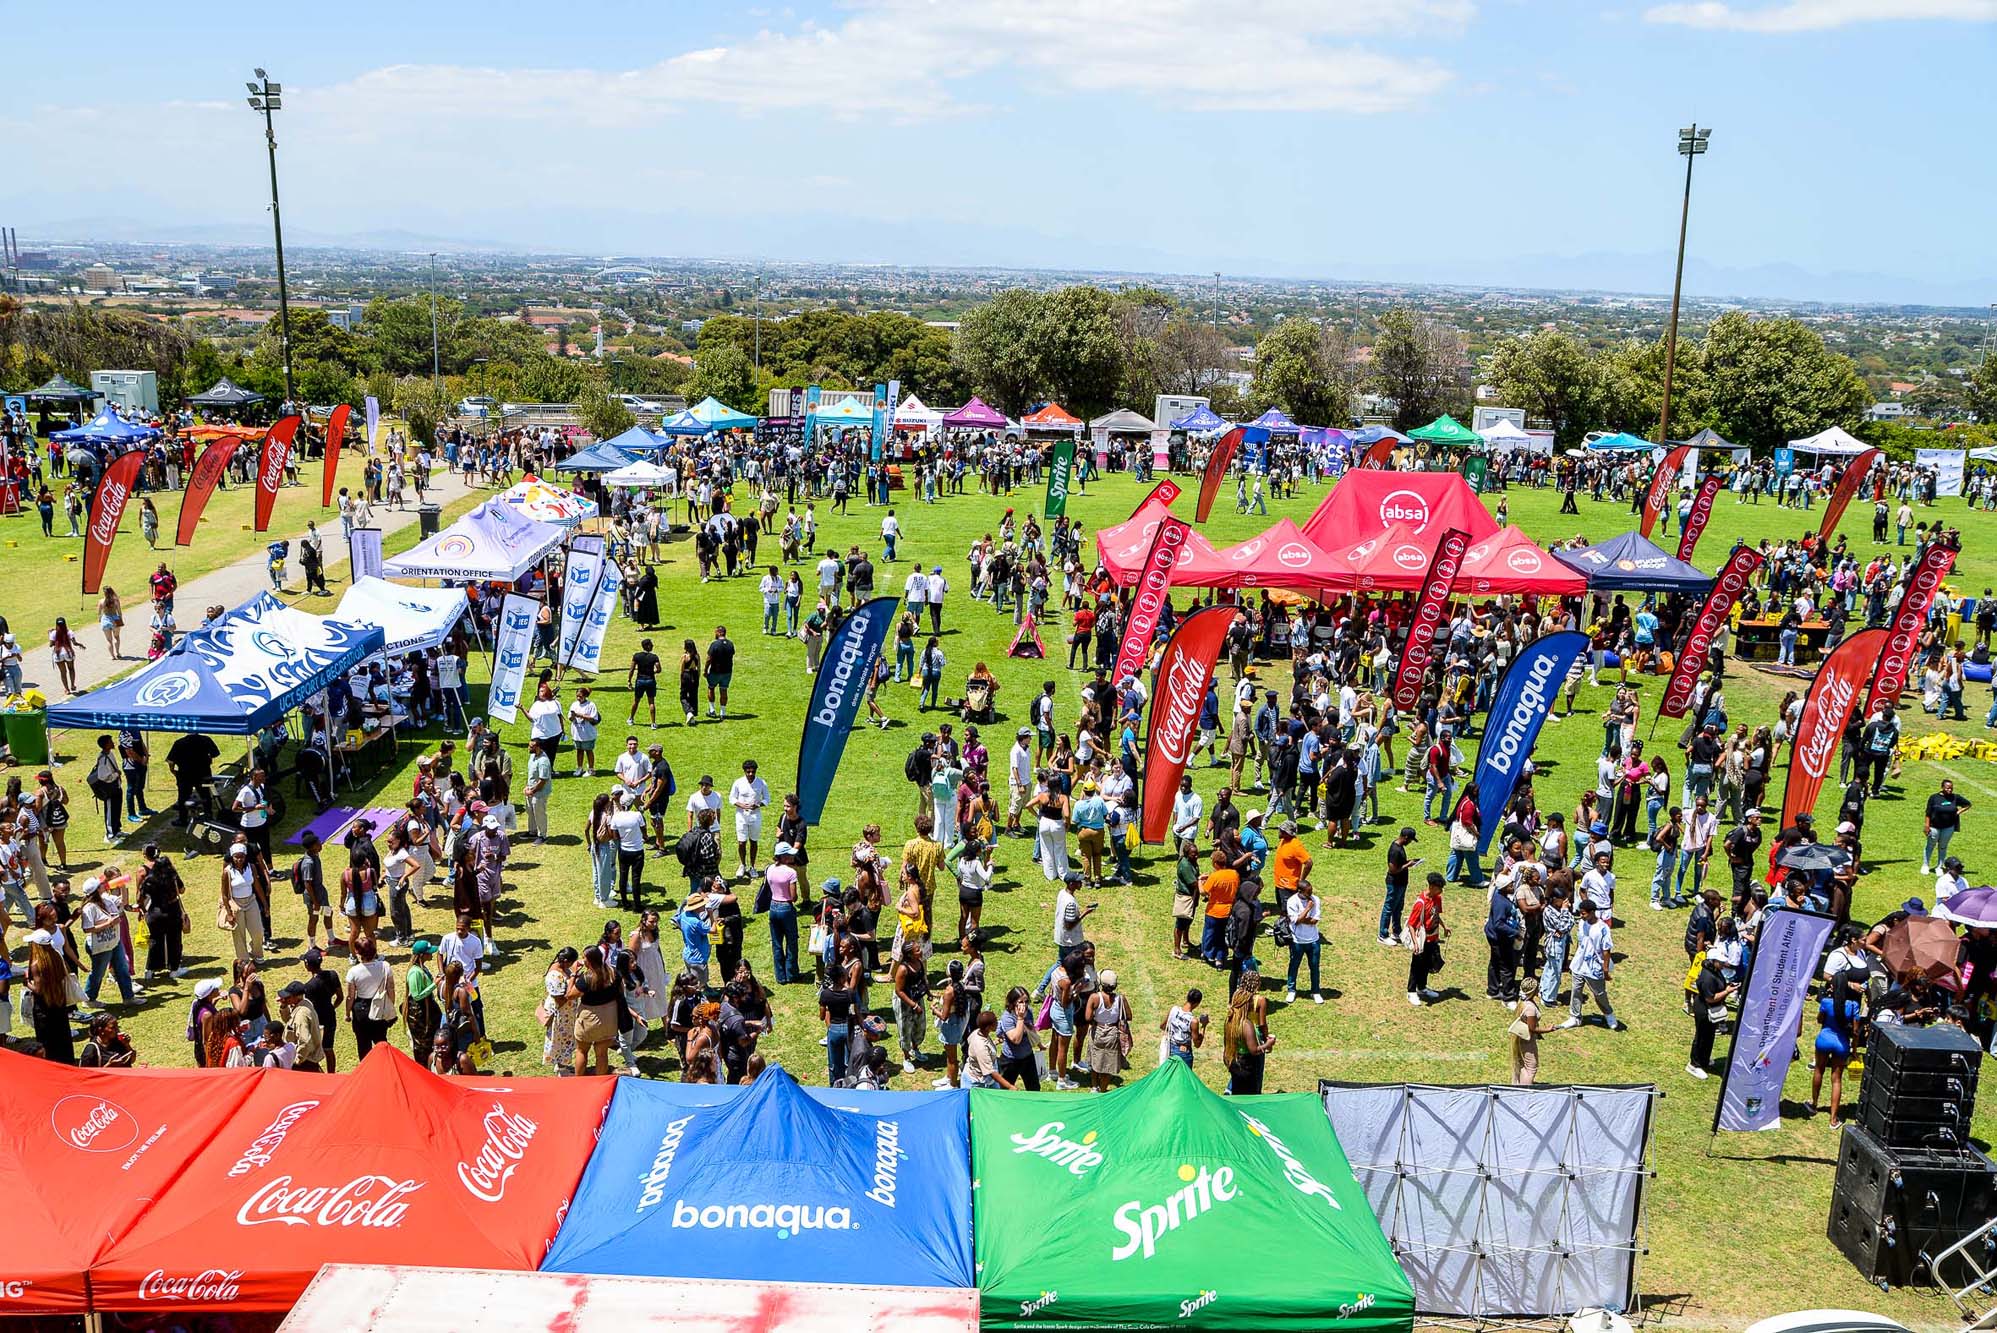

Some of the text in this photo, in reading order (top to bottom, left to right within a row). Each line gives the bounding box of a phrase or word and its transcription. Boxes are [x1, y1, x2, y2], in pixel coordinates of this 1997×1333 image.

[261, 435, 286, 494] Coca-Cola
[1049, 455, 1068, 500] Sprite
[1649, 462, 1676, 511] Coca-Cola
[92, 475, 127, 546] Coca-Cola
[1385, 505, 1424, 521] absa
[1165, 529, 1181, 540] absa
[1282, 551, 1308, 560] absa
[1447, 542, 1464, 552] absa
[1157, 552, 1172, 562] absa
[1397, 553, 1423, 561] absa
[1511, 557, 1537, 565] absa
[401, 567, 494, 578] ORIENTATION OFFICE
[1149, 575, 1164, 585] absa
[1141, 597, 1157, 607] absa
[518, 614, 530, 627] IEC
[1134, 619, 1149, 629] absa
[1417, 628, 1432, 637] absa
[1127, 642, 1142, 652] absa
[511, 654, 522, 666] IEC
[1684, 660, 1699, 668] absa
[1675, 679, 1691, 689] absa
[279, 692, 296, 712] UCT
[296, 677, 320, 701] SPORT
[504, 692, 515, 703] IEC
[1155, 644, 1206, 765] Coca-Cola
[92, 711, 200, 730] UCT SPORT
[1799, 667, 1854, 778] Coca-Cola
[1759, 919, 1797, 1048] Department of Student Affairs
[457, 1101, 540, 1202] Coca-Cola
[1009, 1120, 1103, 1180] Sprite
[121, 1152, 140, 1170] ENJOY
[236, 1175, 428, 1227] Coca-Cola
[1111, 1163, 1238, 1261] Sprite
[138, 1269, 247, 1301] Coca-Cola
[1019, 1290, 1058, 1317] Sprite
[1178, 1289, 1217, 1318] Sprite
[1336, 1292, 1376, 1320] Sprite
